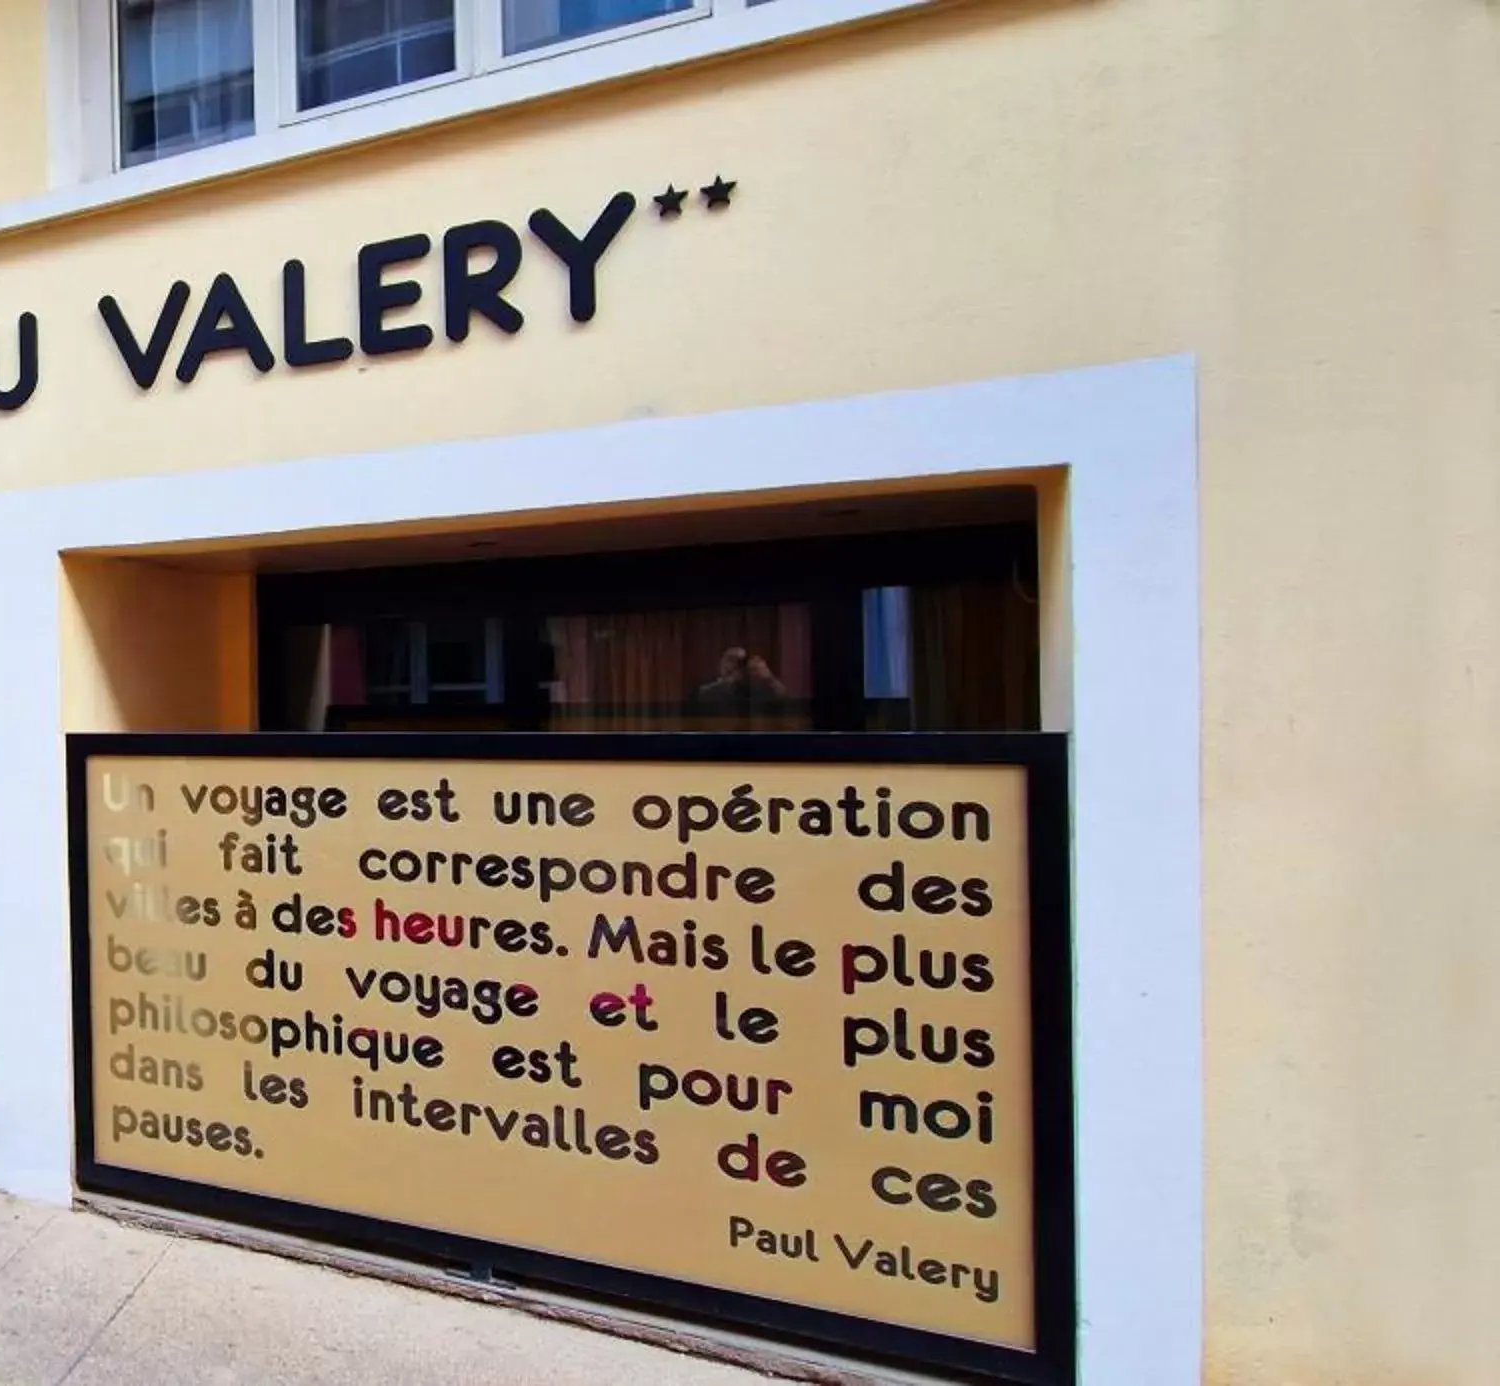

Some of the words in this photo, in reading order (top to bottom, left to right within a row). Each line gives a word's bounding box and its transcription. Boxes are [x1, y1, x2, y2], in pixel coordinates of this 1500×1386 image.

[97, 190, 637, 391] VALERY
[103, 772, 154, 812] Un
[181, 783, 347, 828] voyage
[377, 778, 460, 823] est
[493, 789, 595, 827] une
[632, 784, 990, 844] opération
[104, 829, 167, 875] qui
[219, 832, 303, 876] fait
[359, 848, 775, 902] correspondre
[858, 860, 993, 916] des
[107, 880, 221, 927] villes
[235, 890, 257, 931] à
[272, 894, 357, 938] des
[374, 898, 569, 957] heures.
[587, 913, 729, 969] Mais
[751, 924, 816, 976] le
[842, 934, 995, 995] plus
[107, 935, 207, 981] beau
[246, 949, 303, 991] du
[346, 967, 539, 1024] voyage
[589, 983, 658, 1031] et
[715, 991, 779, 1044] le
[843, 1008, 995, 1068] plus
[109, 993, 444, 1072] philosophique
[492, 1040, 582, 1088] est
[638, 1063, 793, 1115] pour
[860, 1090, 993, 1144] moi
[109, 1044, 203, 1091] dans
[244, 1060, 309, 1108] les
[353, 1076, 660, 1164] intervalles
[717, 1133, 807, 1188] de
[871, 1166, 998, 1218] ces
[112, 1103, 264, 1160] pauses.
[729, 1216, 819, 1263] Paul
[833, 1233, 999, 1303] Valery
